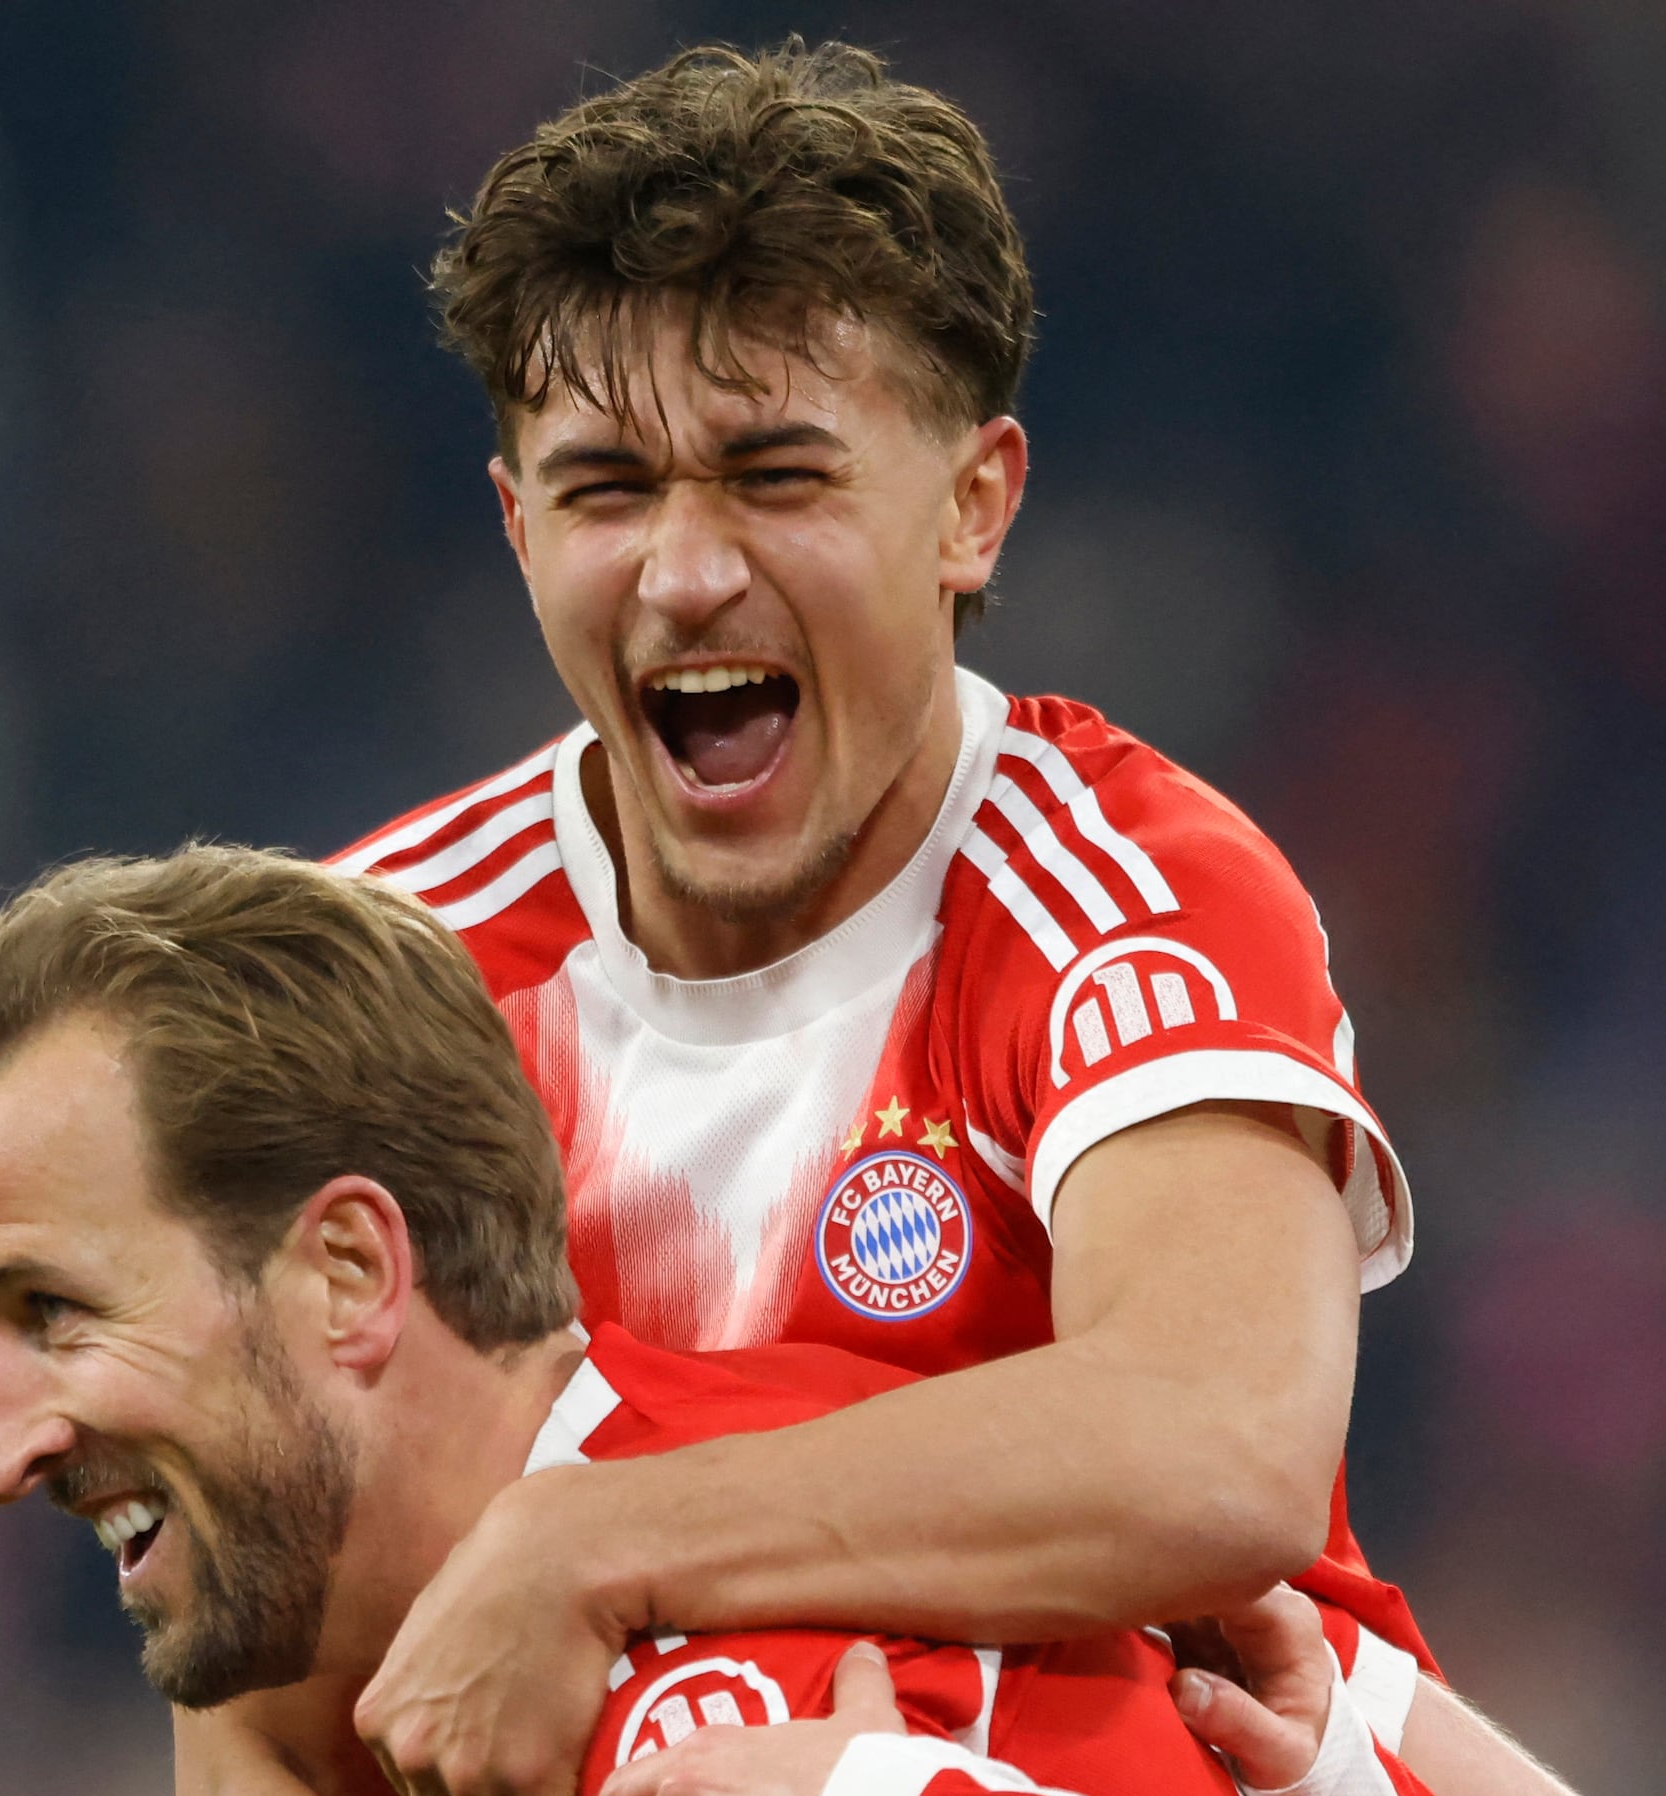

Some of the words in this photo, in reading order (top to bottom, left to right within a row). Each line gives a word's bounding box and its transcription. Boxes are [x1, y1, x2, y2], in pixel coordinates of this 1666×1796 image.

[831, 1188, 862, 1226] FC
[862, 1163, 958, 1222] BAYERN
[831, 1250, 960, 1309] MÜNCHEN
